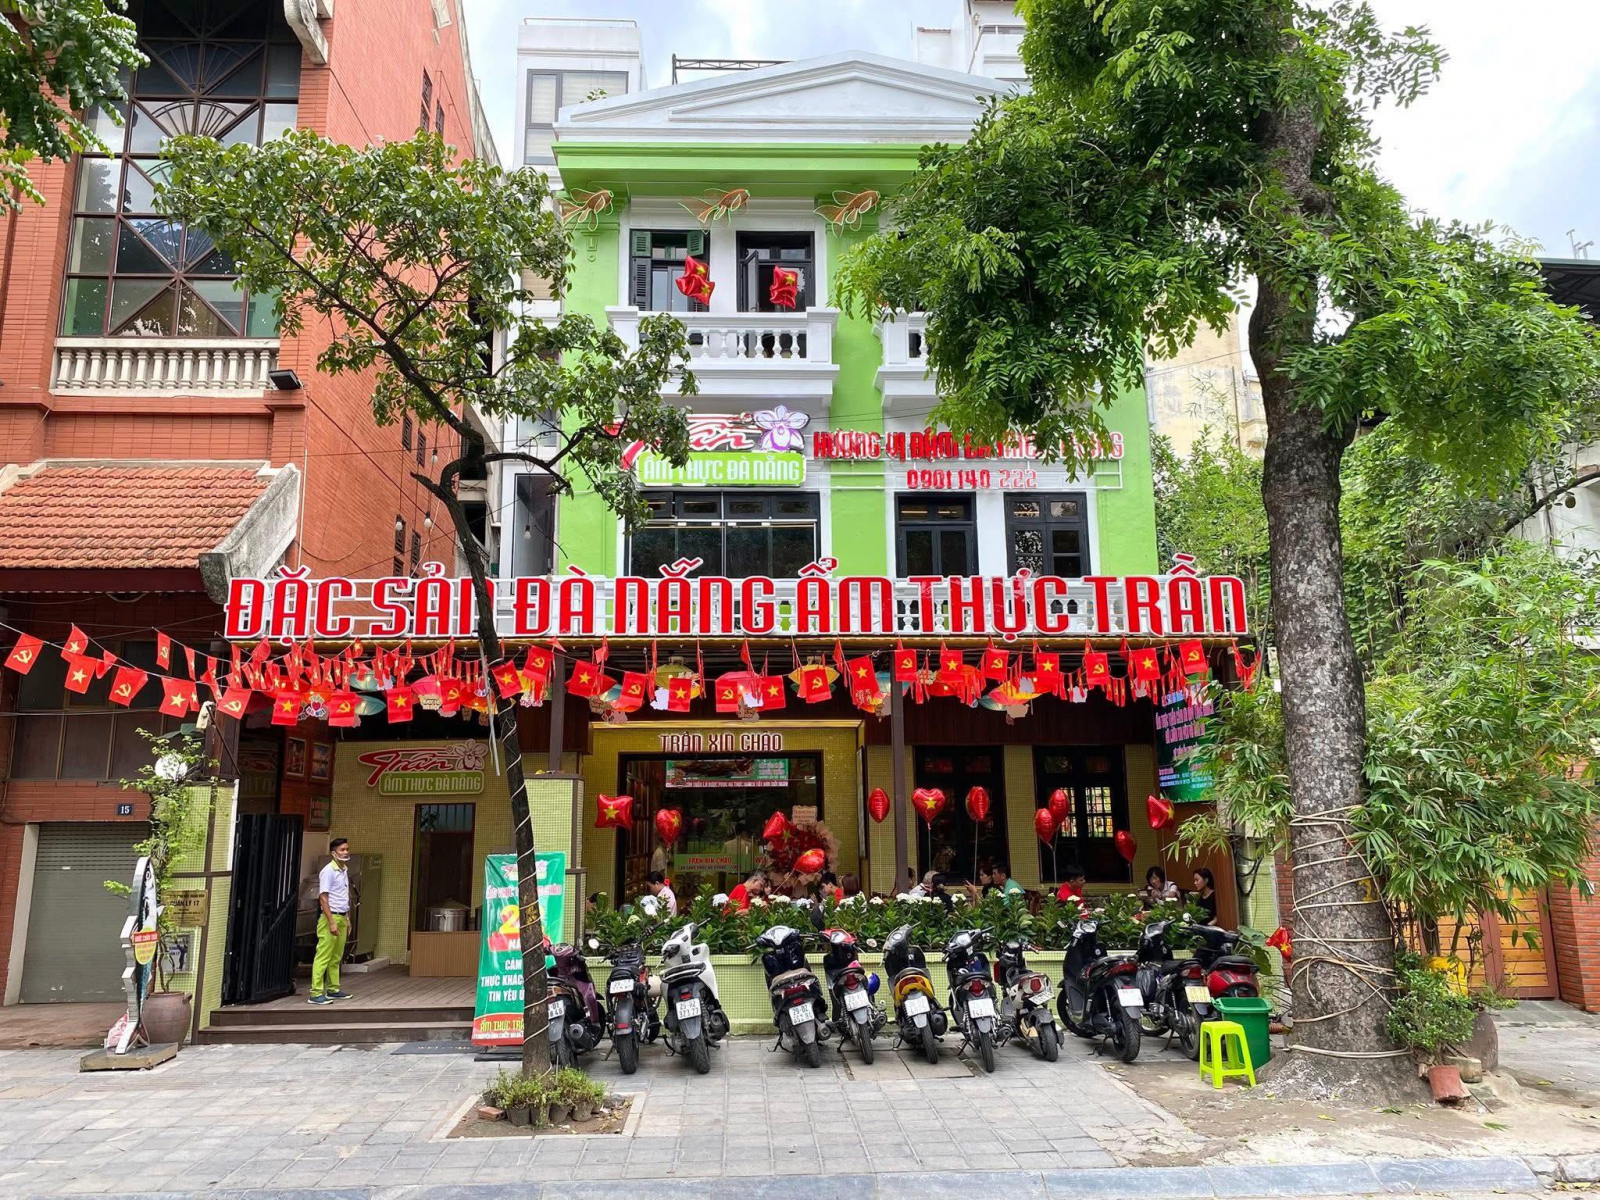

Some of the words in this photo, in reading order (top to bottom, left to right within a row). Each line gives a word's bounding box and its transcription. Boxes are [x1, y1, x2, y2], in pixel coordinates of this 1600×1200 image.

[813, 428, 881, 460] HƯƠNG
[885, 431, 906, 463] VỊ
[727, 456, 750, 481] ĐÀ
[753, 454, 800, 481] NẴNG
[906, 469, 952, 490] 0901
[957, 469, 991, 490] 140
[998, 468, 1038, 490] 222
[223, 564, 357, 646] ĐẶC
[370, 560, 495, 639] SẢN
[512, 564, 600, 638] ĐÀ
[613, 556, 775, 638] NẴNG
[796, 555, 896, 636] ẨM
[907, 567, 1073, 643] THỰC
[1083, 552, 1249, 636] TRẦN
[659, 731, 703, 753] TRẦN
[707, 732, 736, 753] XIN
[739, 730, 784, 753] CHÀO
[384, 772, 405, 792] ẨM
[405, 776, 434, 793] THỰC
[435, 774, 450, 791] ĐÀ
[451, 773, 481, 791] NẴNG
[120, 805, 130, 815] 15
[481, 976, 501, 989] THỰC
[488, 990, 502, 1002] TIN
[503, 988, 518, 1002] YÊU
